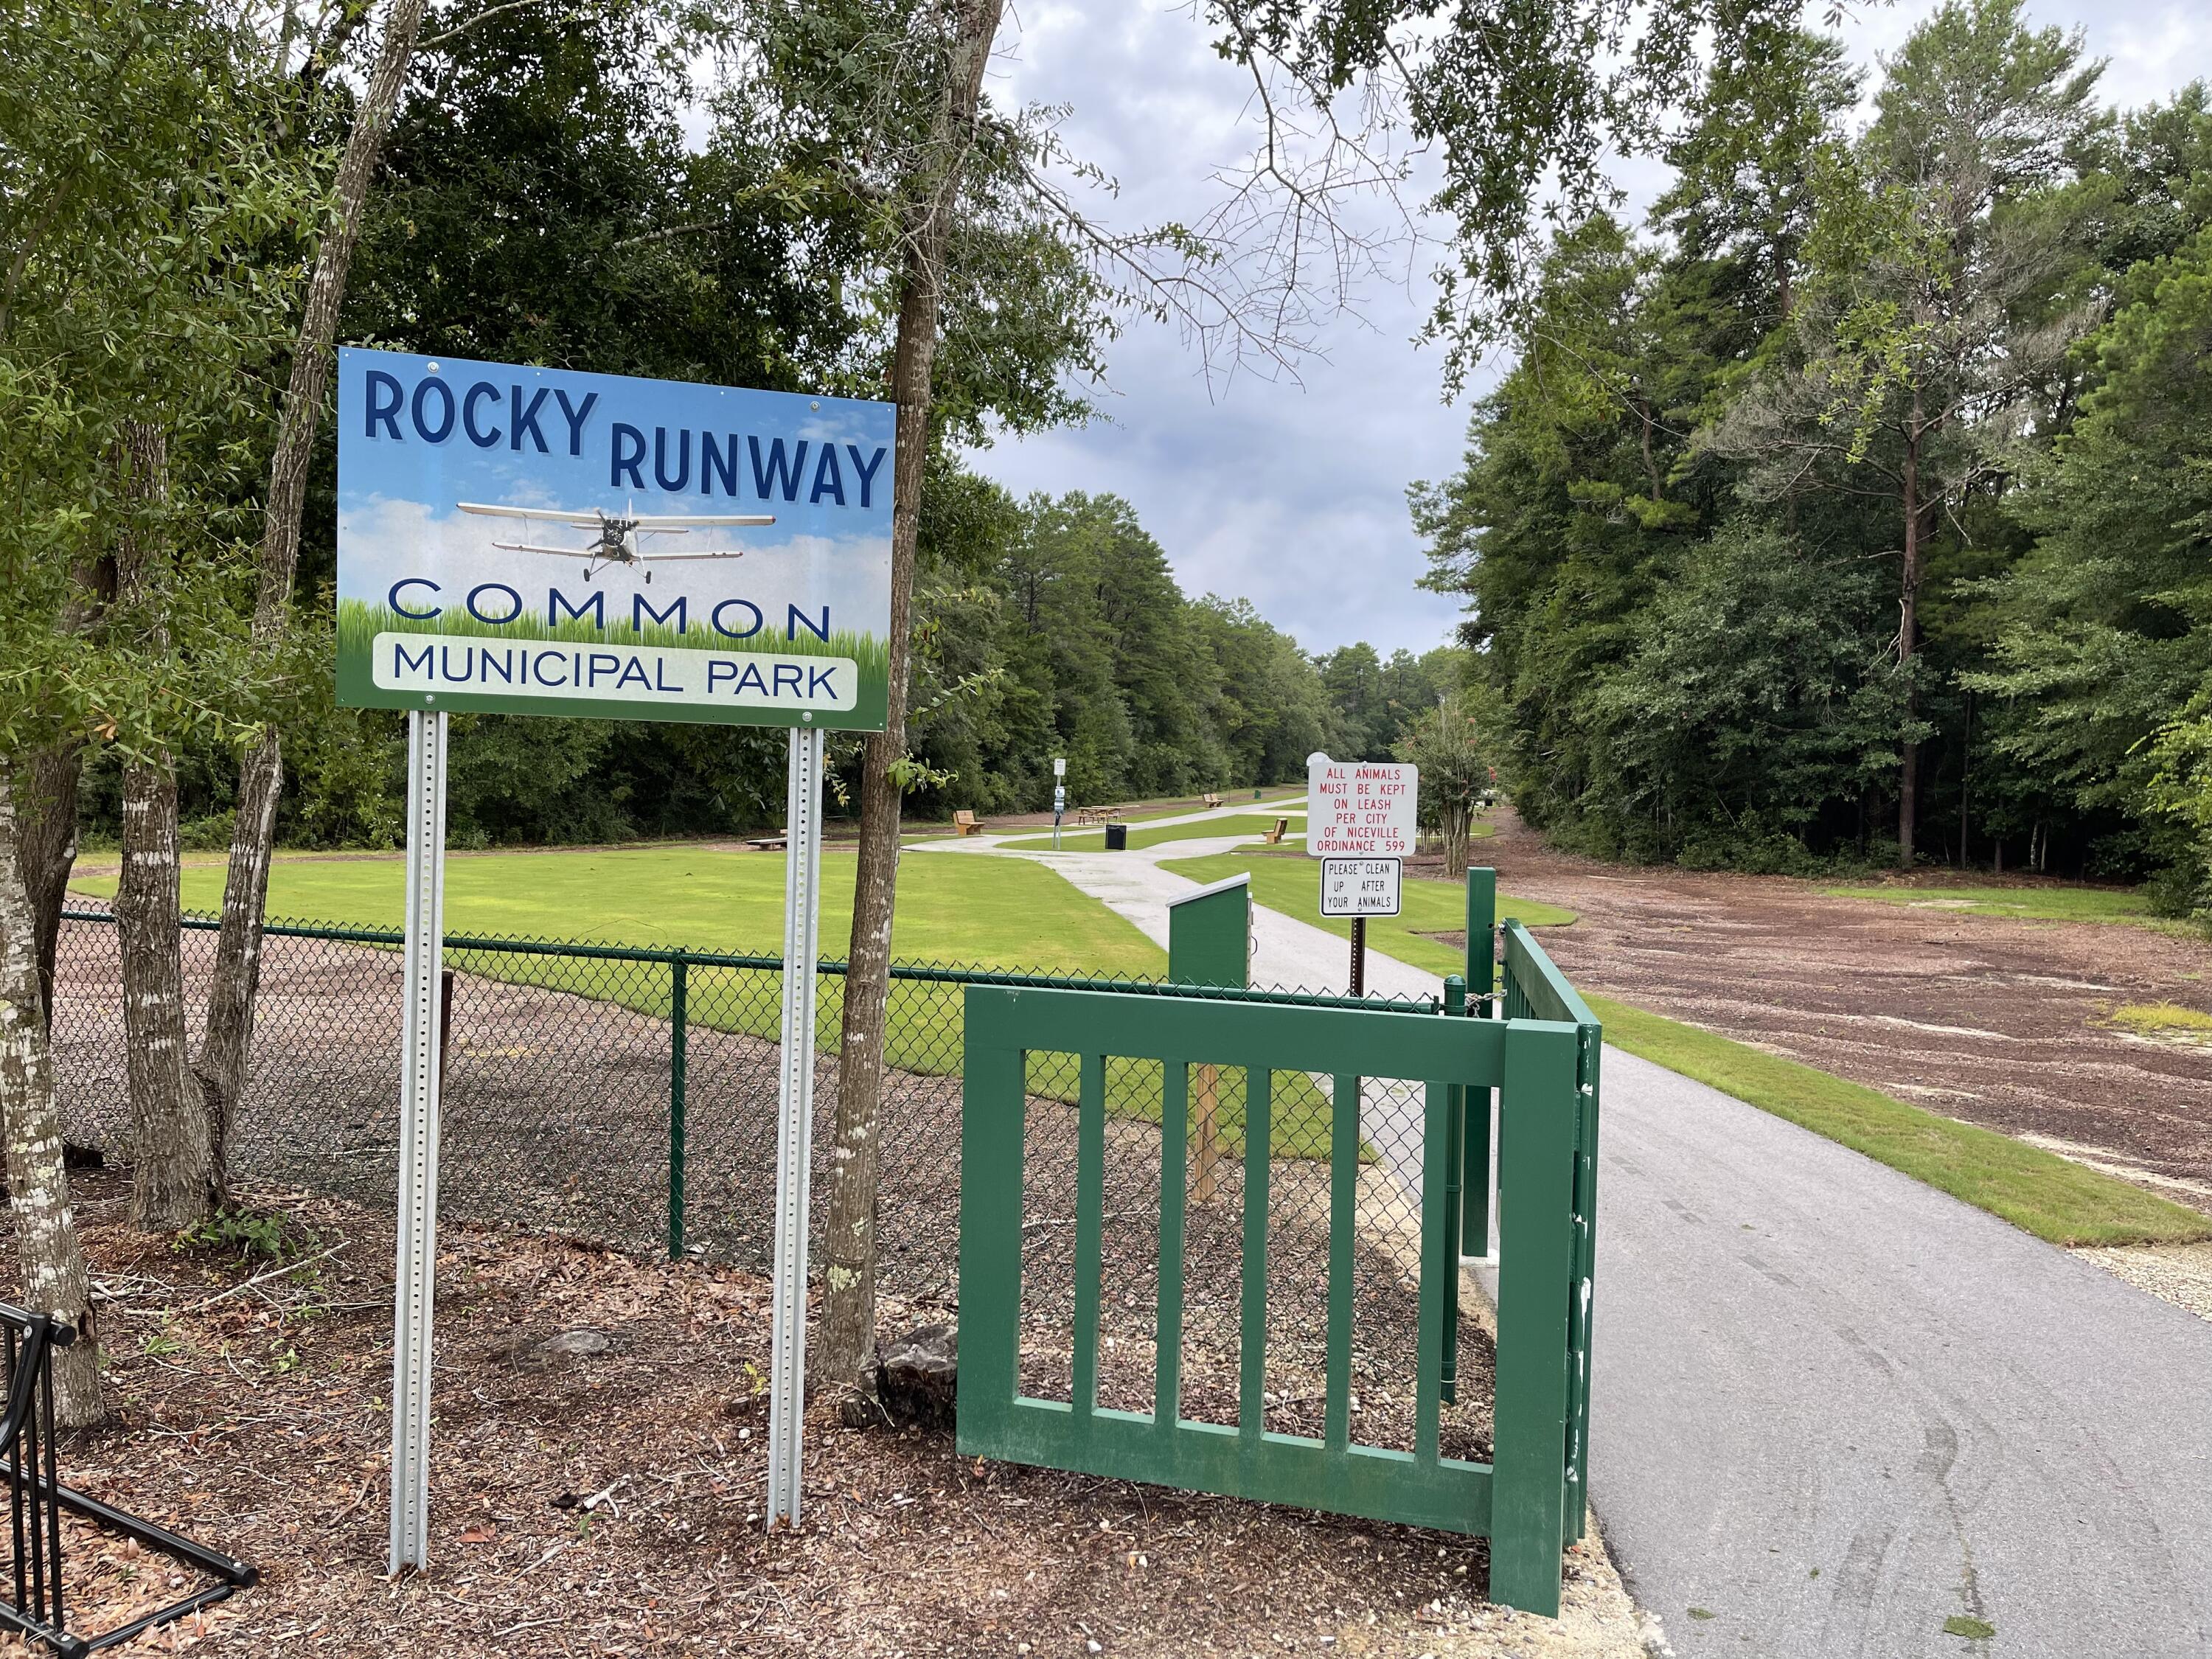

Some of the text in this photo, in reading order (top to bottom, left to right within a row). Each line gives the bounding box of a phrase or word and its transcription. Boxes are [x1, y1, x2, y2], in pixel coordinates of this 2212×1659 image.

[366, 370, 888, 508] ROCKY RUNWAY
[389, 578, 830, 641] COMMON
[394, 644, 838, 700] MUNICIPAL PARK
[1326, 768, 1400, 780] ALL ANIMALS
[1320, 783, 1406, 795] MUST BE KEPT
[1334, 799, 1391, 810] ON LEASH
[1336, 813, 1388, 824] PER CITY
[1324, 827, 1399, 838] OF NICEVILLE
[1317, 841, 1405, 852] ORDINANCE 599
[1329, 863, 1390, 875] PLEASE CLEAN
[1334, 880, 1385, 892] UP AFTER
[1328, 897, 1391, 908] YOUR ANIMALS
